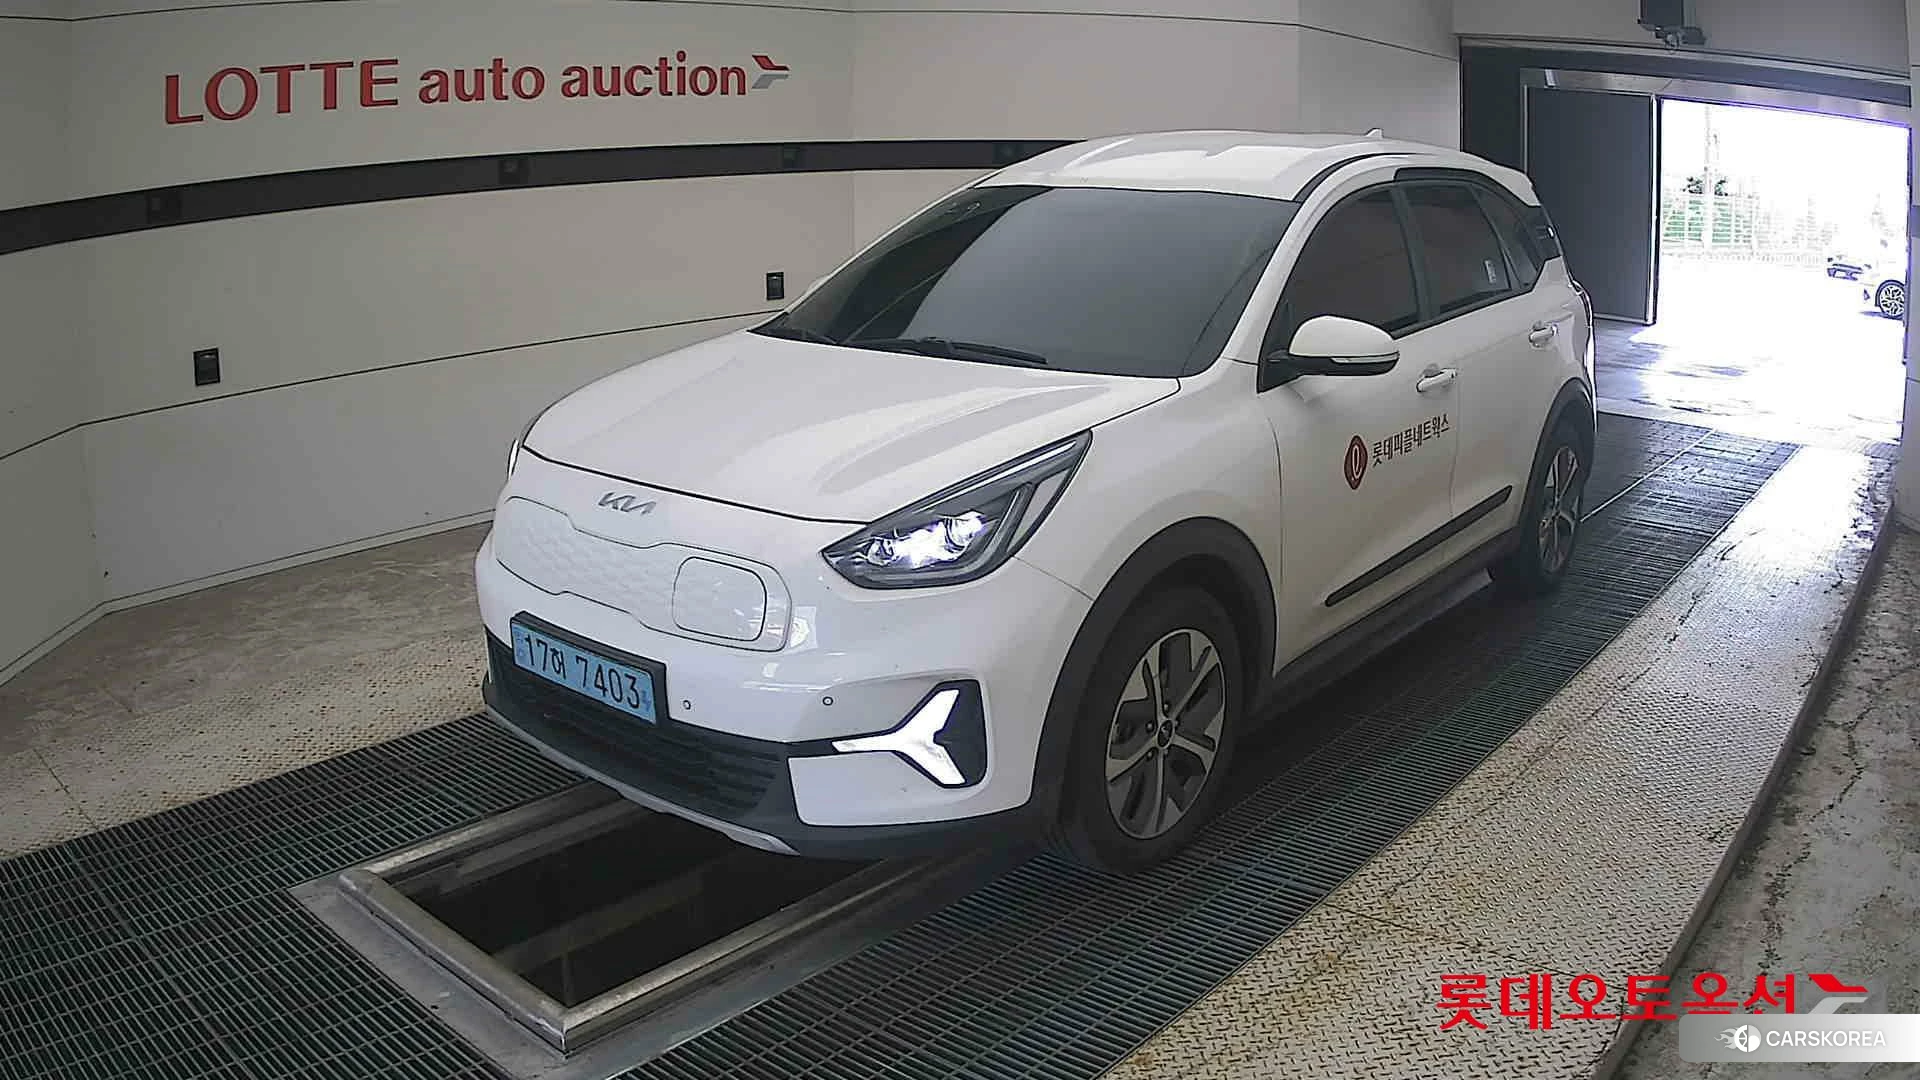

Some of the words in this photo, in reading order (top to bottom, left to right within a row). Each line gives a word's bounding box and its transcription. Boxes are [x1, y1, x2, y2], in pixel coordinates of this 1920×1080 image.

[165, 58, 399, 125] LOTTE
[418, 57, 546, 104] auto
[560, 50, 748, 98] auction
[575, 654, 640, 709] 7403
